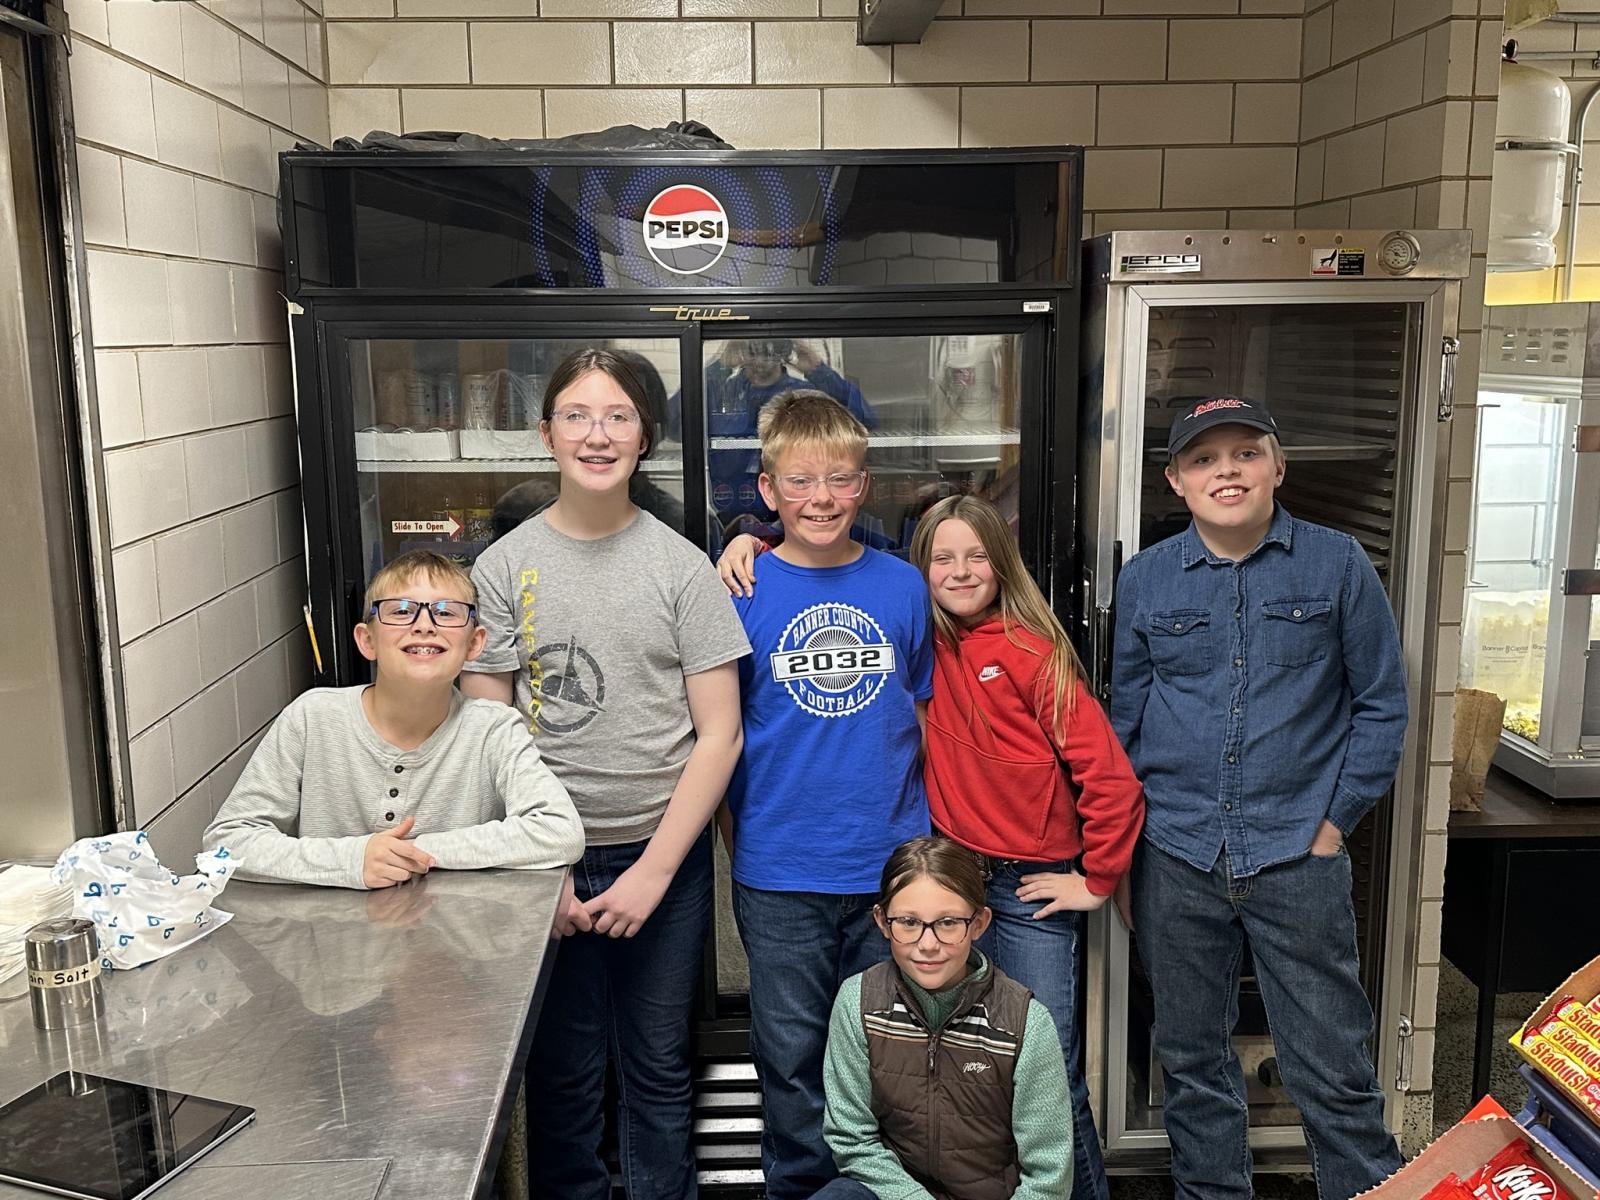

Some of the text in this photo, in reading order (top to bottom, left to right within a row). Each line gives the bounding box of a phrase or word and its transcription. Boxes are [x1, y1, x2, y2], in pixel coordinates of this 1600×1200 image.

[649, 220, 723, 239] PEPSI
[1128, 255, 1199, 265] EPCO
[650, 306, 750, 320] true
[394, 522, 444, 532] Slide To Open
[792, 608, 871, 648] BANNER COUNTY
[788, 650, 881, 674] 2032
[981, 666, 1000, 676] NIKE
[798, 678, 874, 711] FOOTBALL
[54, 968, 89, 985] Salt
[1530, 1042, 1590, 1090] Starburst
